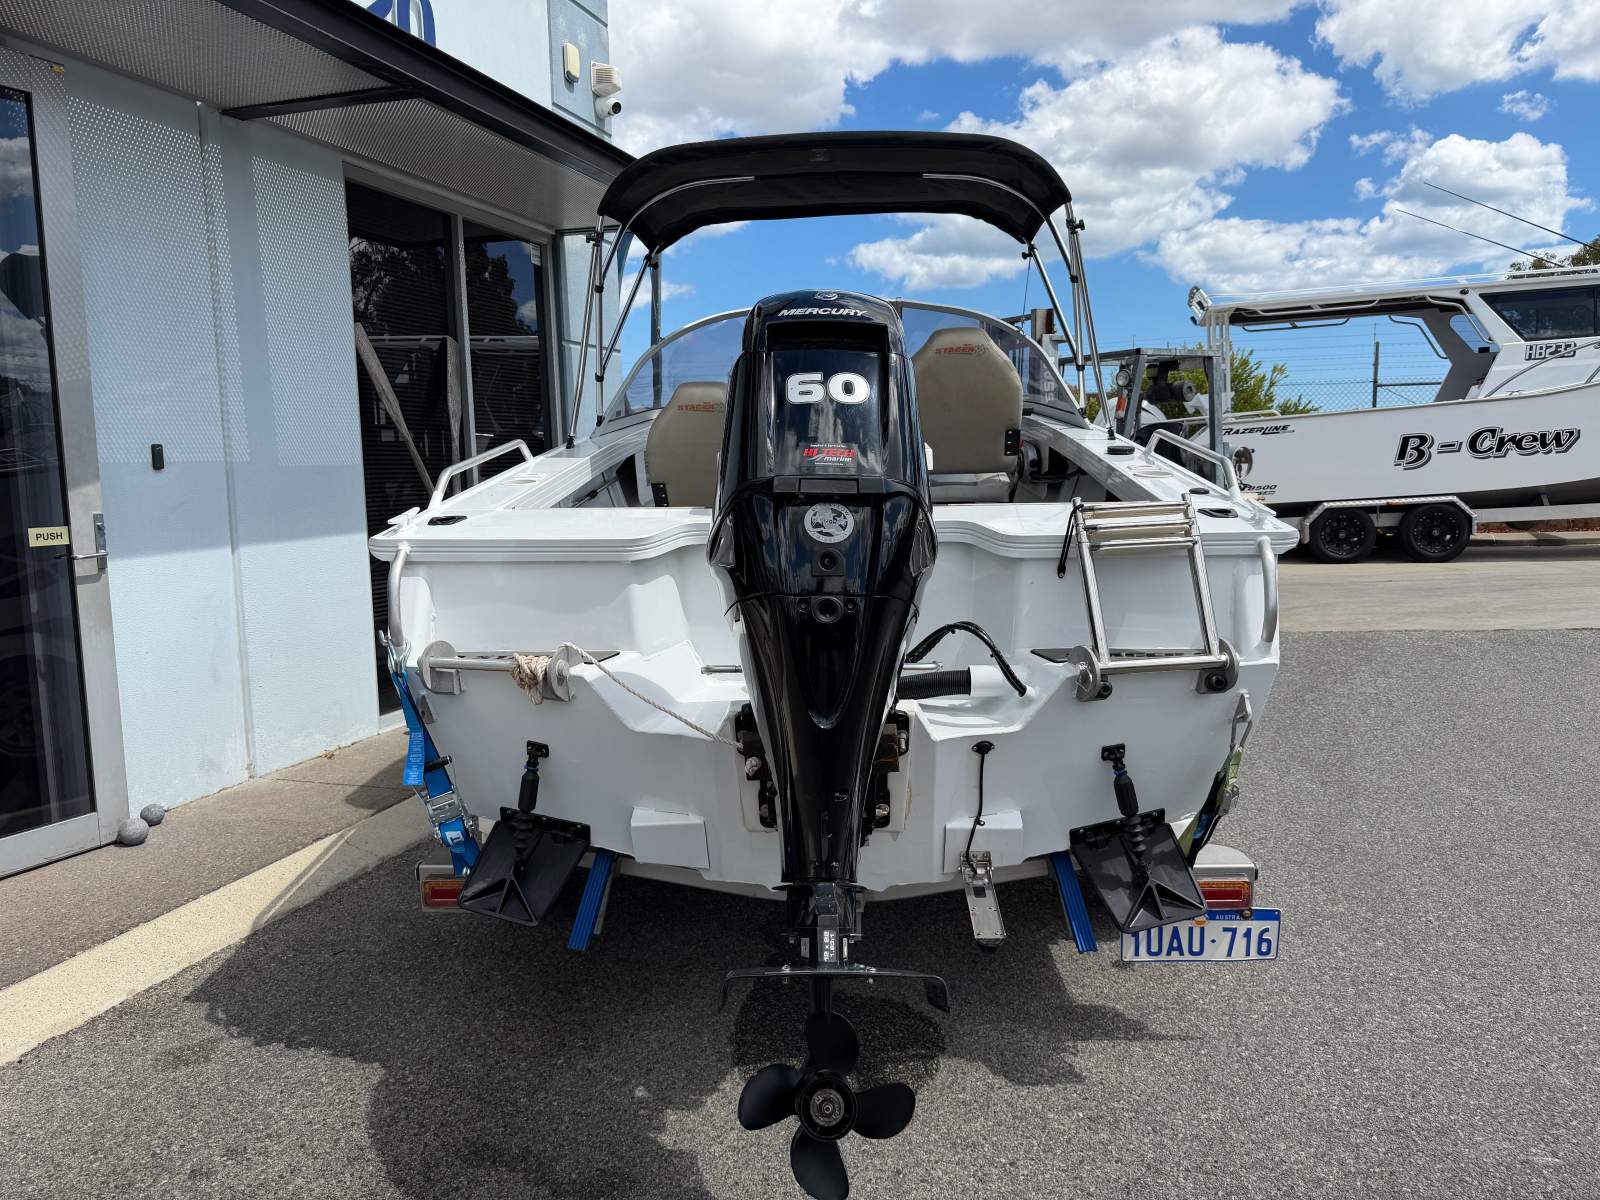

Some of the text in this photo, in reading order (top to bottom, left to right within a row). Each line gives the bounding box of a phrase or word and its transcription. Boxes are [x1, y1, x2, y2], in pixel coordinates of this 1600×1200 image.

[778, 307, 868, 317] MERCURY
[785, 371, 871, 404] 60
[35, 531, 63, 541] PUSH
